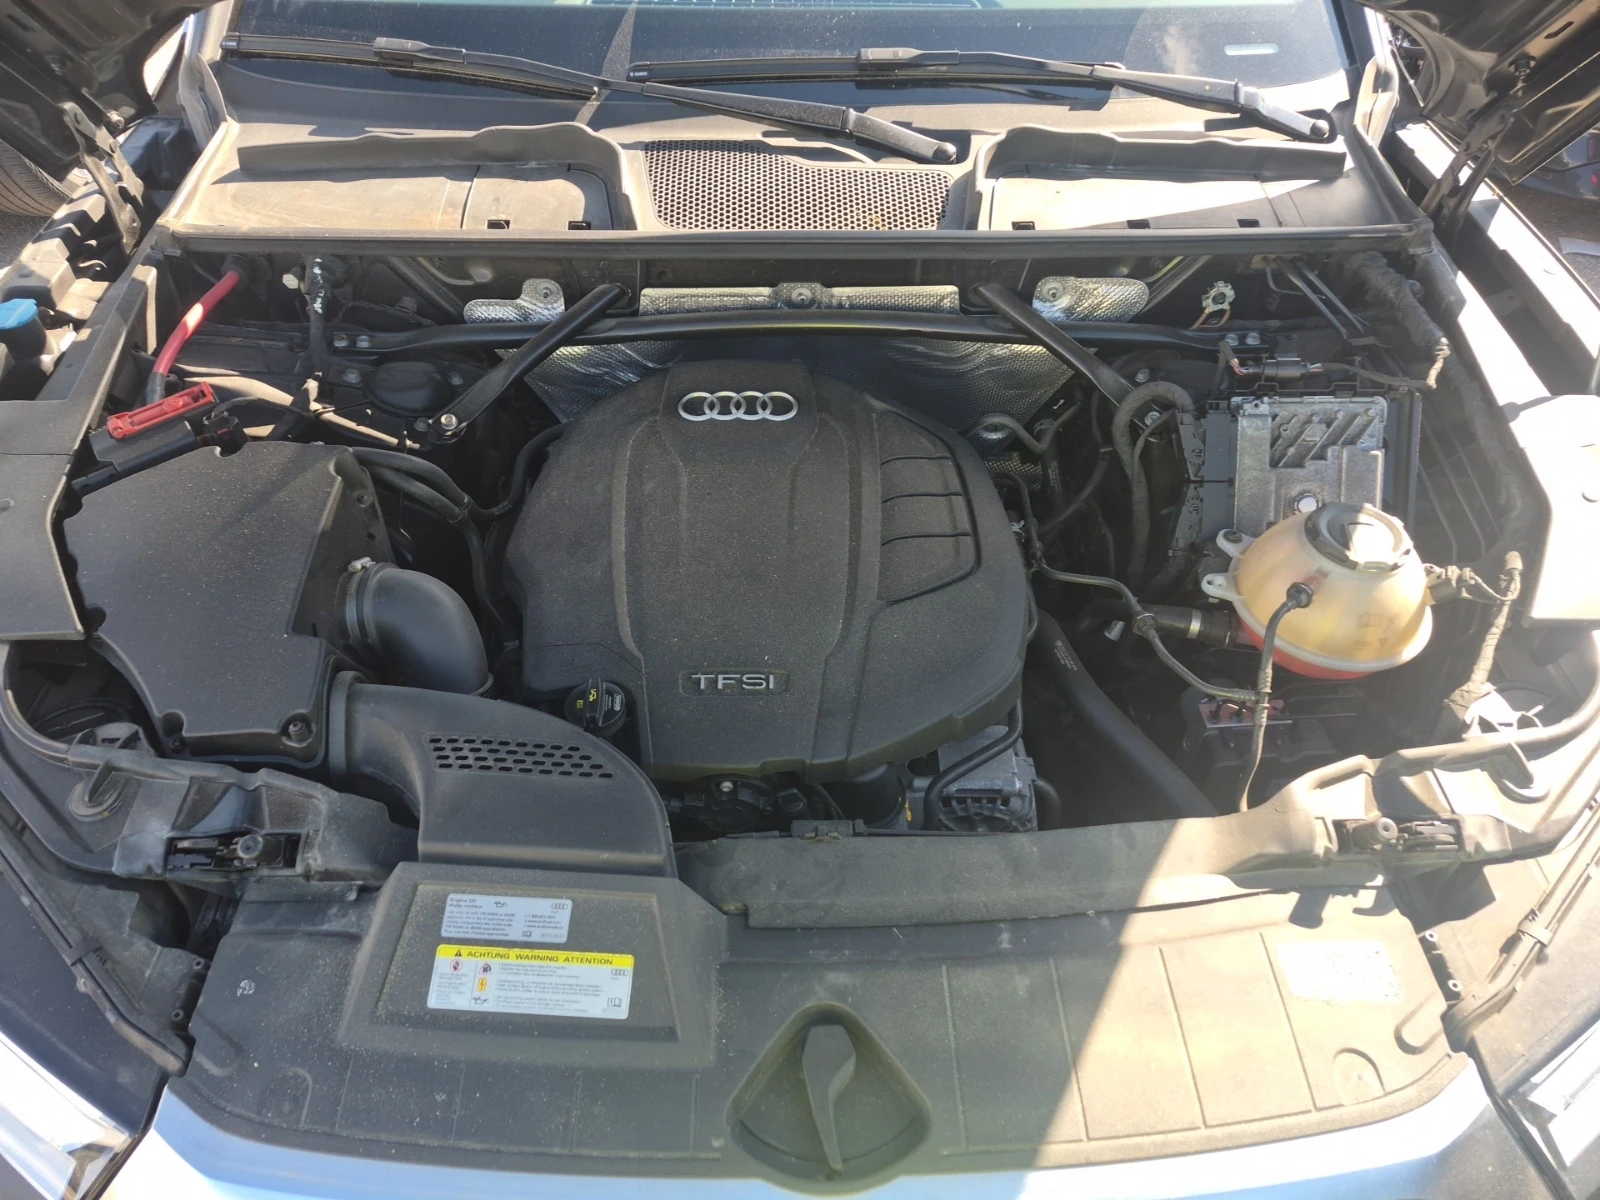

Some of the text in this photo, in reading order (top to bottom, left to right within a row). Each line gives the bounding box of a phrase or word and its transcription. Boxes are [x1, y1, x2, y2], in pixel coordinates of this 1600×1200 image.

[691, 674, 774, 689] TFSI
[467, 951, 613, 965] ACHTUNG WARNING ATTENTION
